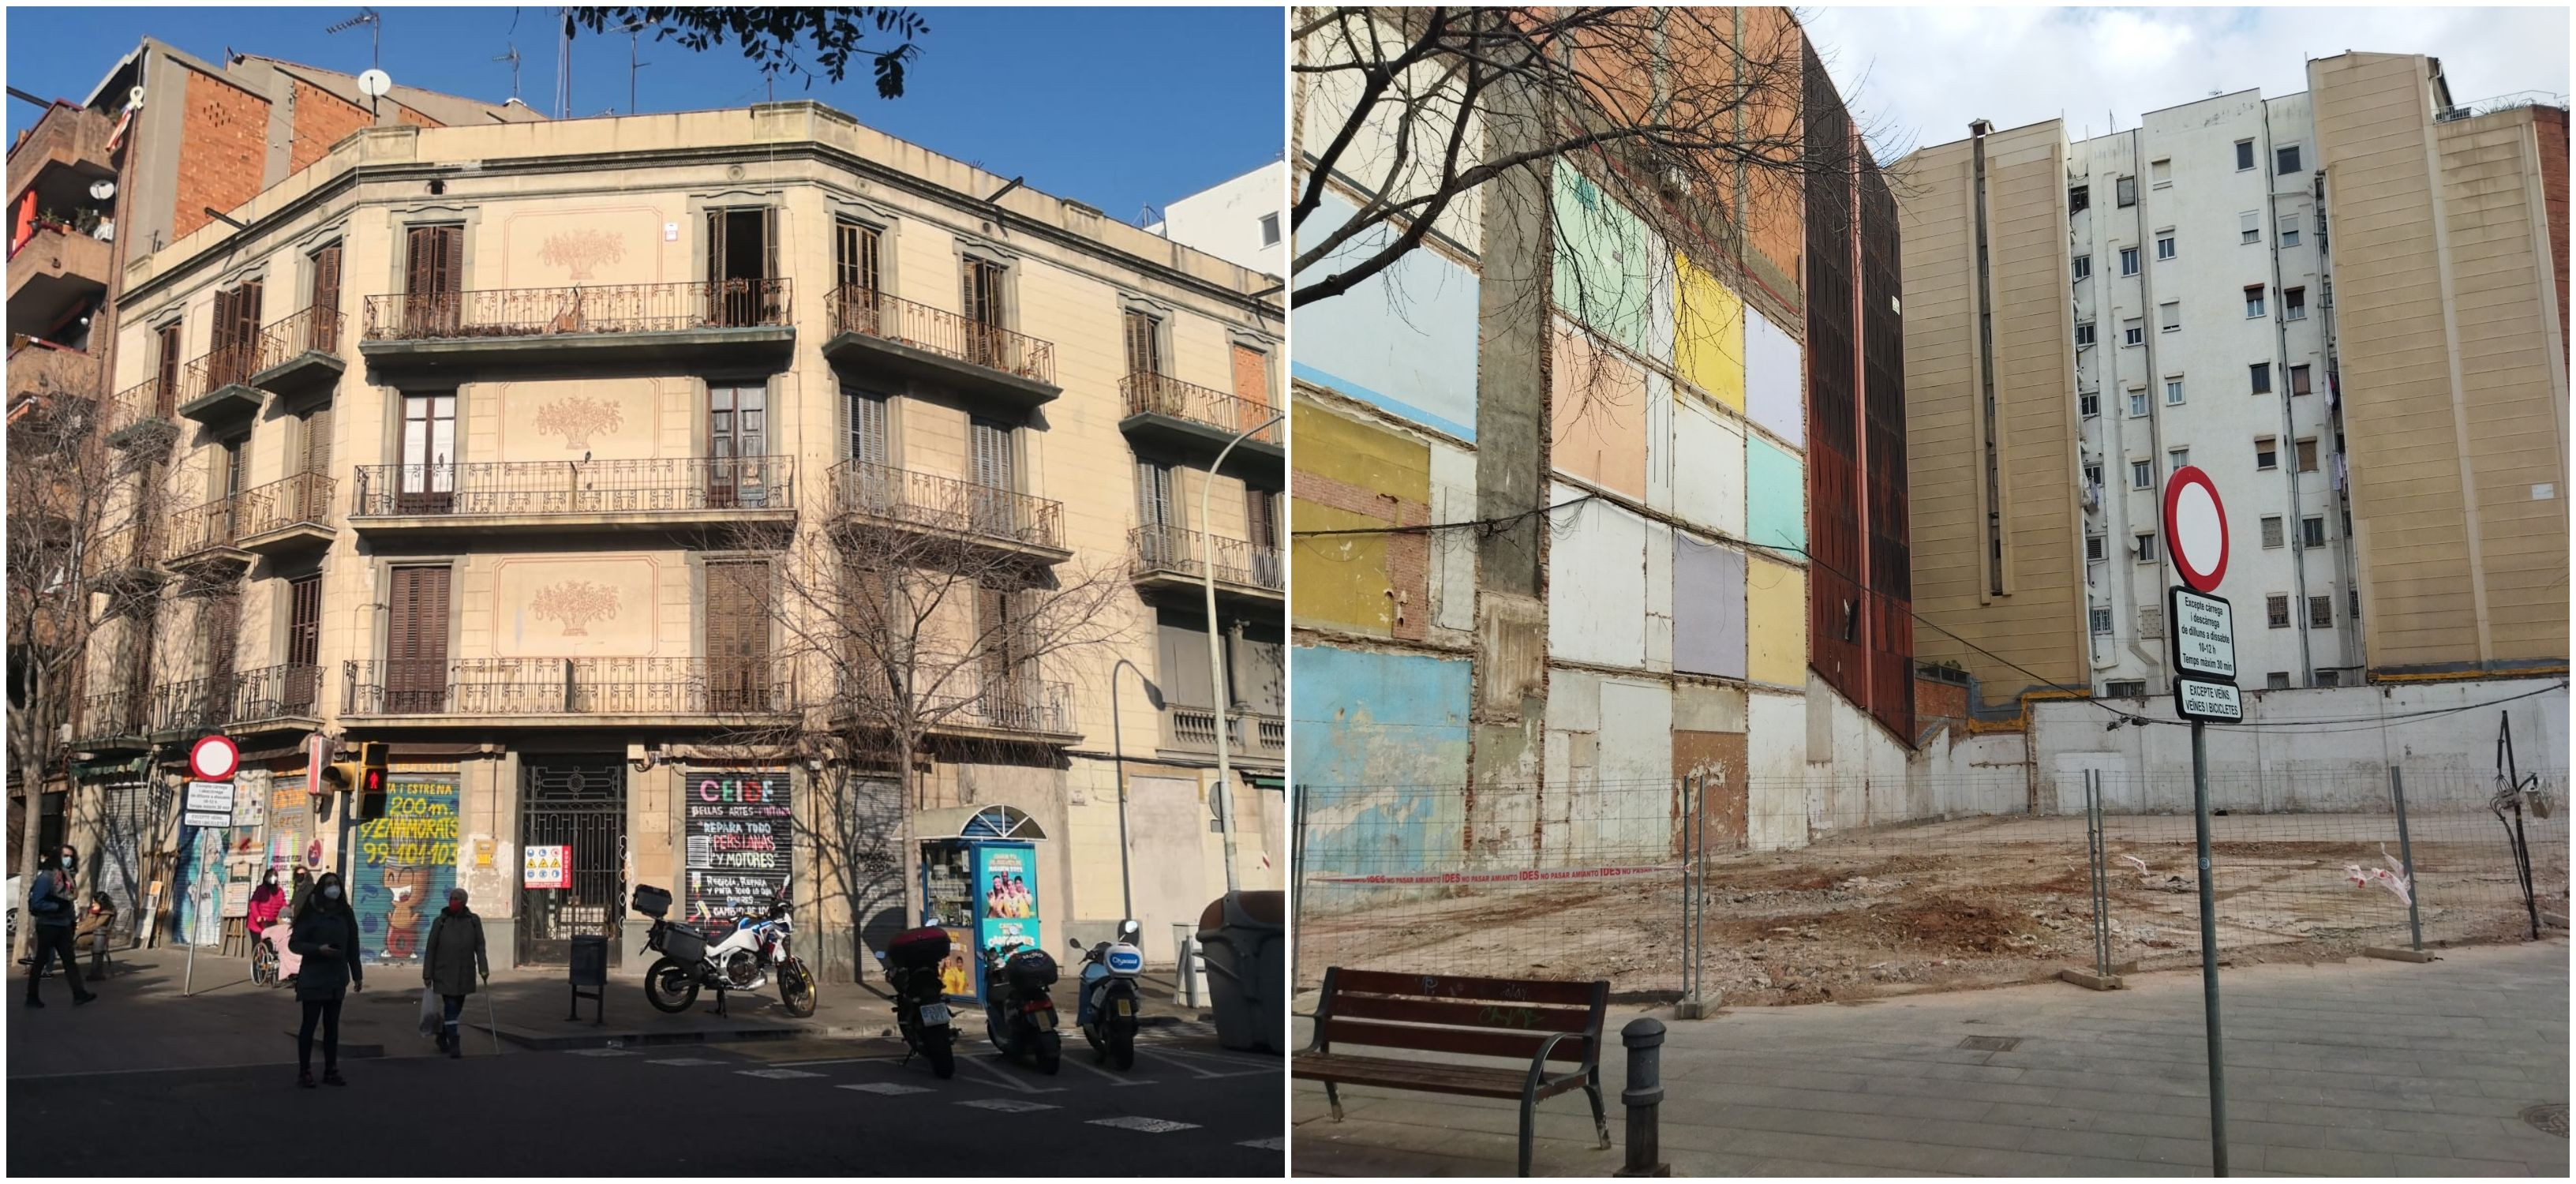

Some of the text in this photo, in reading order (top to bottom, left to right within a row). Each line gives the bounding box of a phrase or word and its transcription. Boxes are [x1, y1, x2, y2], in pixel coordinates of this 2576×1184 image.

[2185, 597, 2222, 616] Excepte càrrega
[2194, 613, 2219, 629] descàrrega
[2181, 624, 2188, 634] de
[2188, 626, 2205, 639] dilluns
[2210, 631, 2230, 643] dissabte
[2199, 642, 2216, 654] 10-12 h
[2182, 653, 2232, 671] Temps màxim 30 min
[2189, 685, 2214, 698] EXCEPTE
[2209, 703, 2238, 715] BICICLETES
[407, 784, 452, 795] ESTRENA
[699, 780, 773, 803] CEIDE
[390, 796, 427, 815] 200
[691, 806, 724, 817] BELLAS
[713, 834, 776, 851] PERSIANAS
[1442, 873, 1461, 883] IDES
[1519, 871, 1540, 881] IDES
[1571, 870, 1598, 879] AMIANTO
